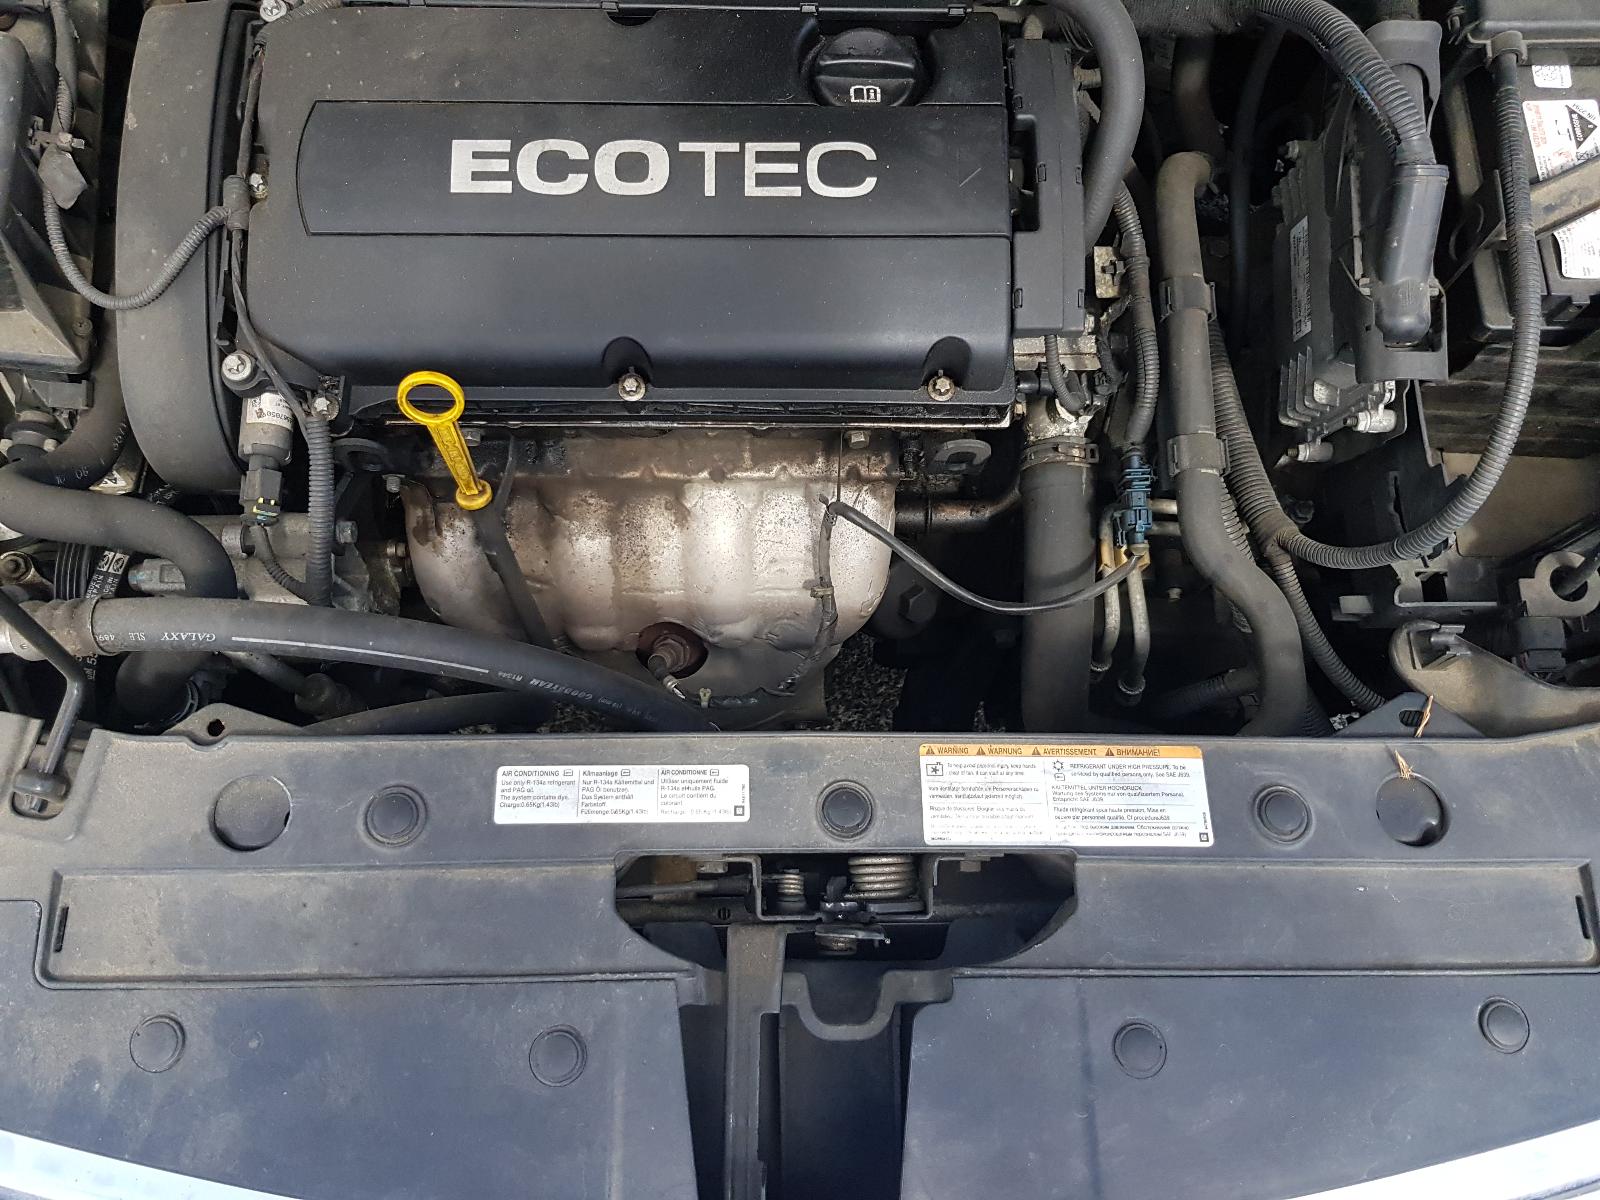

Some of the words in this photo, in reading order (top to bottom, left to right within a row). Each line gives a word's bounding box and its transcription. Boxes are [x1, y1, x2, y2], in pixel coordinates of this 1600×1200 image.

[450, 138, 878, 199] ECOTEC
[129, 632, 145, 640] SLE
[161, 632, 216, 641] GALAXY
[529, 678, 593, 700] GOODYEAR
[1043, 748, 1096, 756] AVERTISSEMENT
